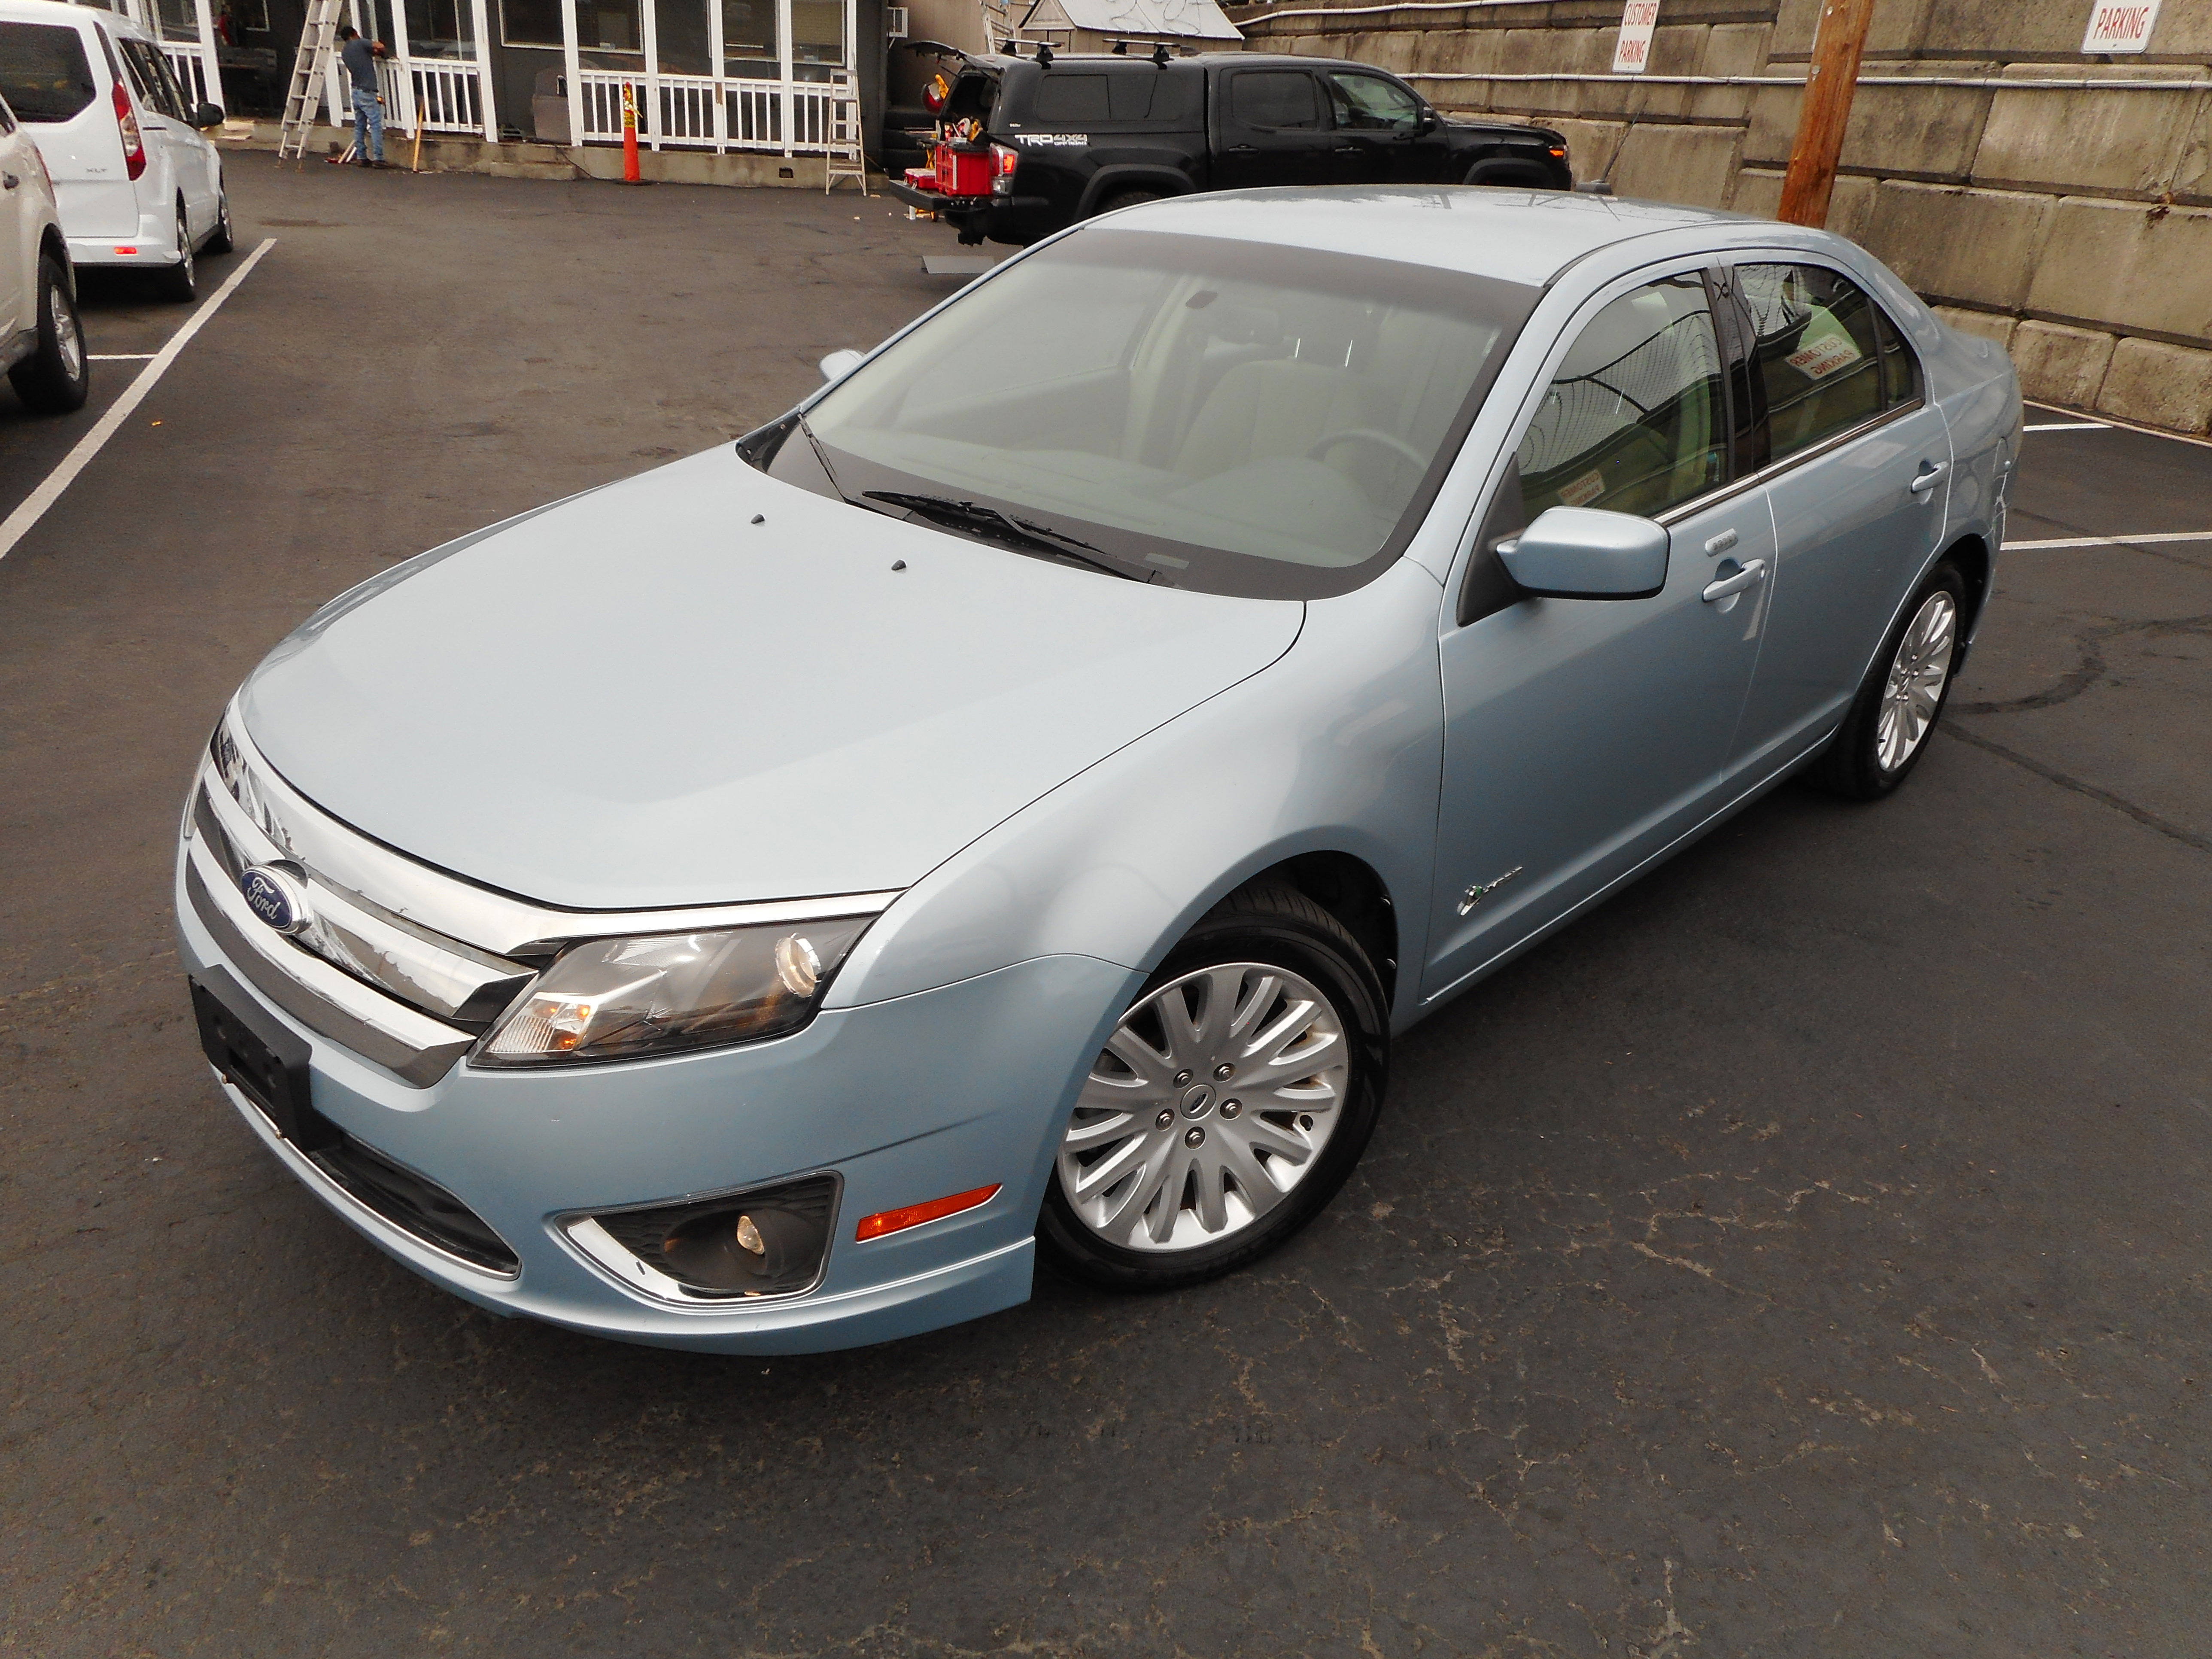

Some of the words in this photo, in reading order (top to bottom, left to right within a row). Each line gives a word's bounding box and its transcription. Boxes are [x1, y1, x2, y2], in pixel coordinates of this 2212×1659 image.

[1624, 3, 1657, 26] CUSTOMER
[2093, 6, 2149, 39] PARKING
[1618, 40, 1646, 63] PARKING
[1015, 134, 1053, 146] TRD
[247, 877, 281, 920] Ford
